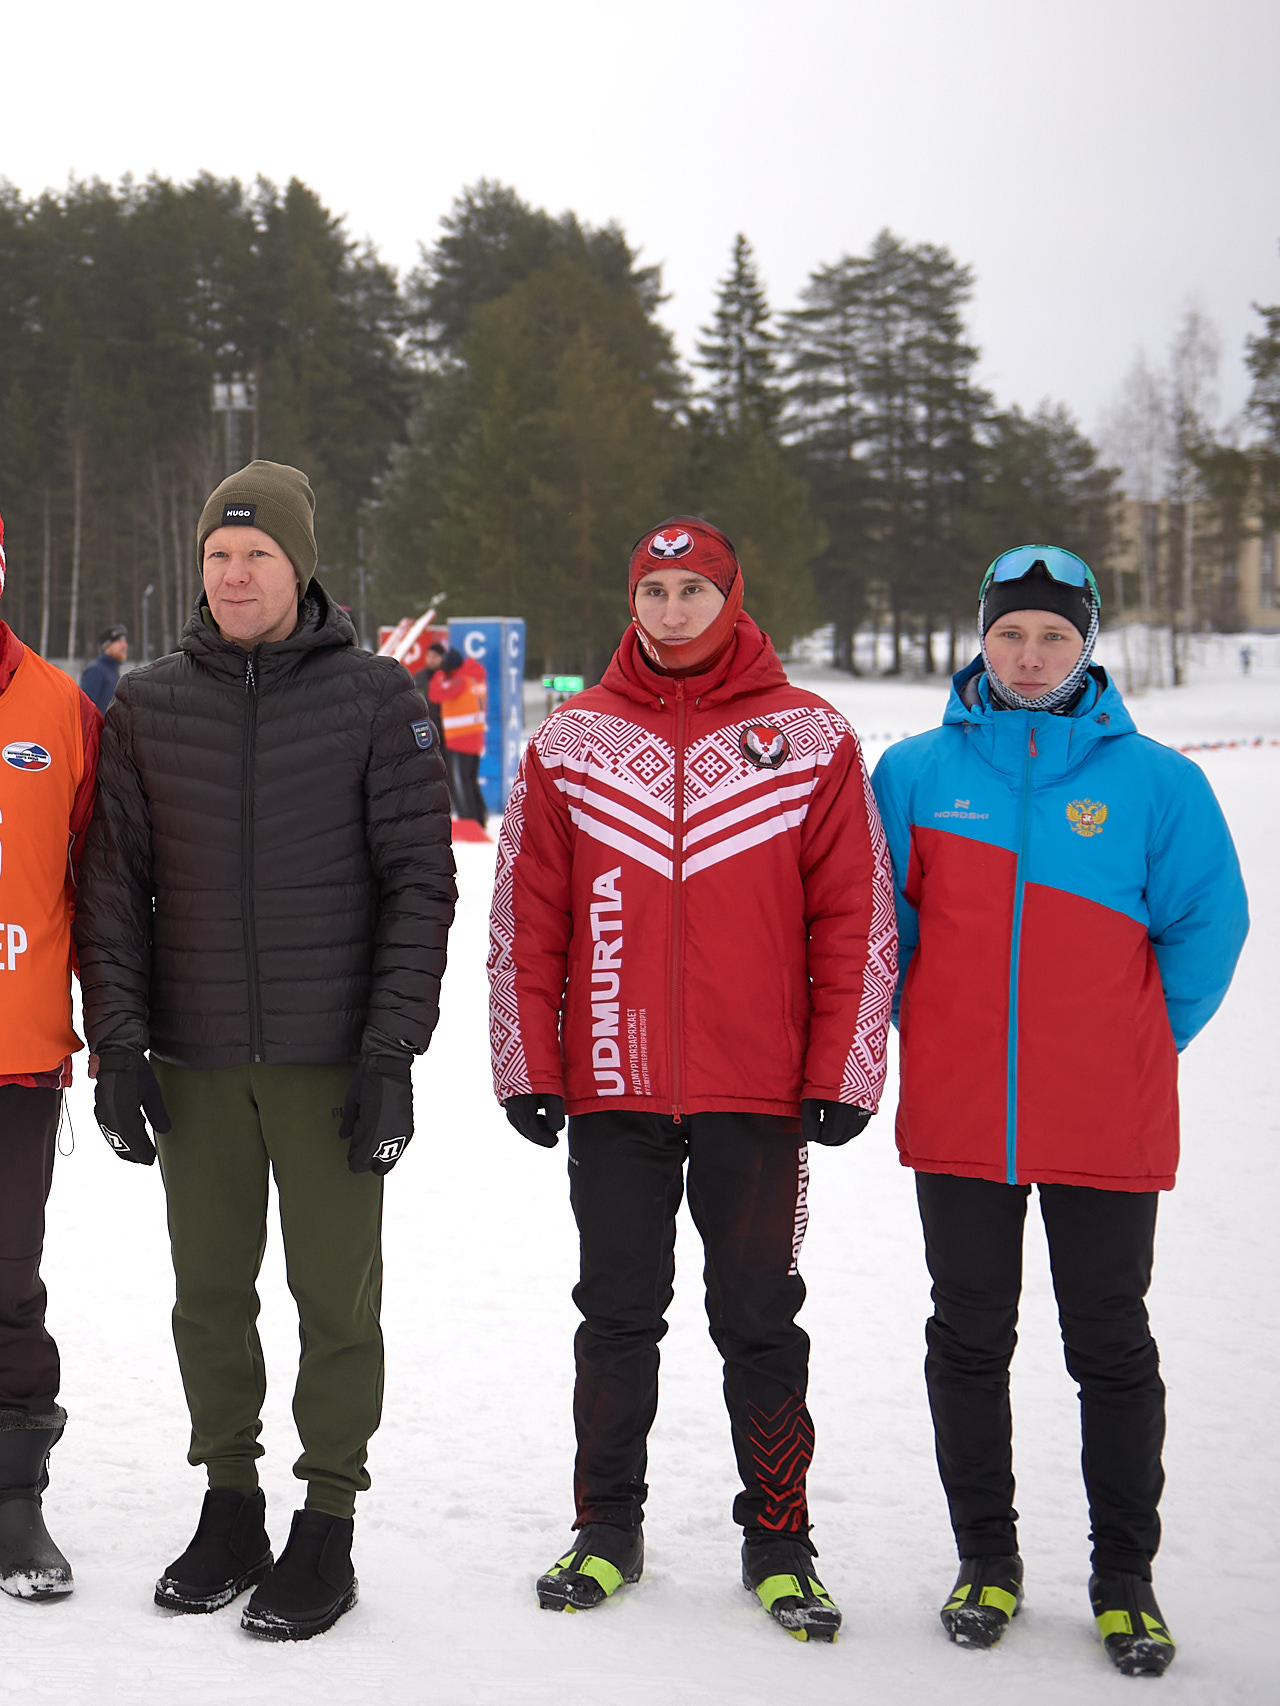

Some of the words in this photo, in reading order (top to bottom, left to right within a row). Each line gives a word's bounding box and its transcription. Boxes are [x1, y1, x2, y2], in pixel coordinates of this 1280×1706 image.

[934, 811, 989, 820] NORDSKI
[590, 866, 625, 1097] UDMURTIA
[627, 1008, 643, 1096] #УДМУРТИЯЗАРЯЖАЕТ
